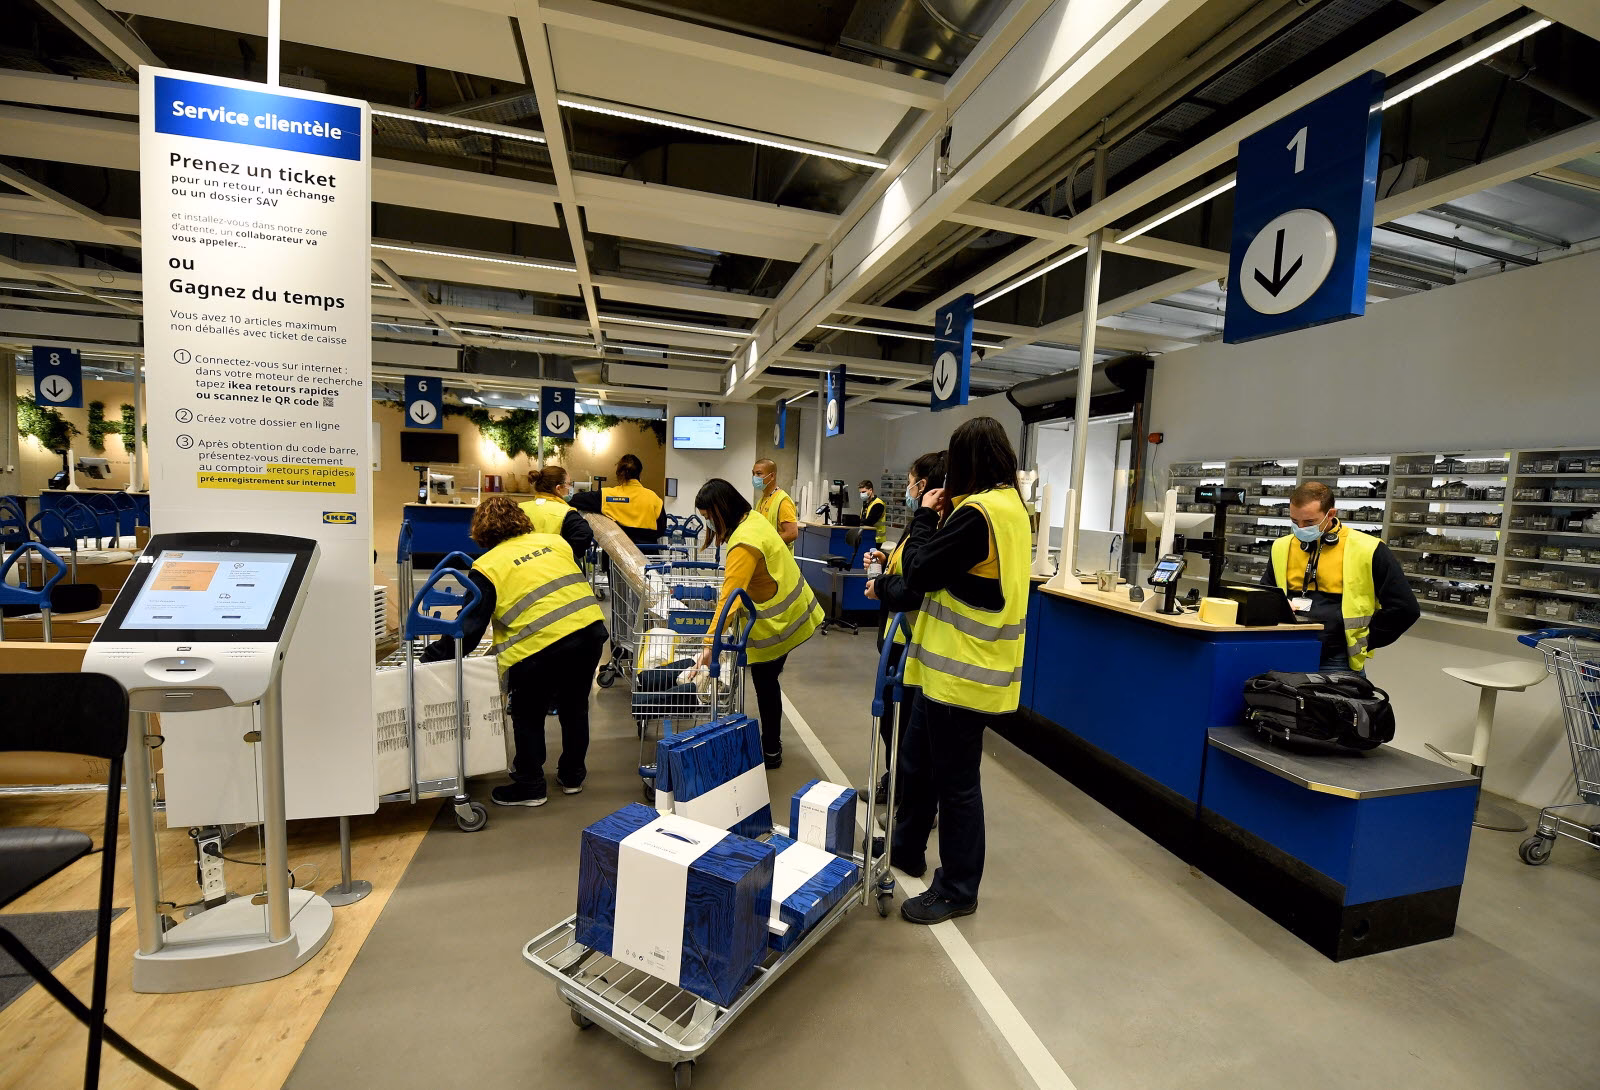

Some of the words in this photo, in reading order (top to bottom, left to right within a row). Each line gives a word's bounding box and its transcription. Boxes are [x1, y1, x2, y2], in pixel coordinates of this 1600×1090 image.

[172, 101, 249, 126] Service
[254, 113, 342, 139] clientèle
[1286, 126, 1307, 174] 1
[170, 153, 239, 174] Prenez
[247, 166, 271, 179] un
[279, 168, 336, 188] ticket
[172, 175, 200, 184] pour
[223, 182, 264, 194] retour,
[286, 188, 335, 203] échange
[210, 191, 252, 203] dossier
[256, 197, 278, 207] SAV
[184, 213, 250, 227] installez-vous
[252, 221, 275, 230] dans
[172, 235, 196, 243] vous
[236, 231, 303, 244] collaborateur
[169, 258, 194, 270] ou
[170, 279, 246, 299] Gagnez
[252, 286, 276, 301] du
[283, 291, 344, 311] temps
[170, 310, 198, 320] Vous
[201, 314, 226, 322] avez
[230, 315, 241, 323] 10
[244, 318, 282, 327] articles
[285, 322, 337, 332] maximum
[944, 312, 953, 336] 2
[195, 324, 240, 335] déballés
[270, 331, 298, 340] ticket
[301, 333, 314, 341] de
[50, 352, 60, 366] 8
[195, 355, 279, 368] Connectez-vous
[302, 363, 342, 373] internet
[195, 367, 222, 376] dans
[255, 373, 294, 381] moteur
[313, 376, 363, 386] recherche
[831, 374, 836, 389] 3
[196, 380, 225, 389] tapez
[229, 381, 252, 390] ikea
[255, 385, 296, 393] retours
[299, 387, 339, 396] rapides
[418, 380, 428, 392] 6
[214, 394, 259, 402] scannez
[262, 395, 271, 403] le
[275, 396, 291, 405] QR
[294, 398, 319, 406] code
[554, 391, 562, 403] 5
[196, 414, 226, 423] Créez
[259, 418, 297, 427] dossier
[315, 421, 340, 431] ligne
[198, 439, 229, 449] Après
[232, 441, 283, 451] obtention
[302, 445, 326, 453] code
[329, 446, 358, 455] barre,
[199, 451, 279, 462] présentez-vous
[282, 455, 343, 465] directement
[215, 465, 263, 474] comptoir
[201, 476, 284, 484] pré-enregistrement
[513, 545, 553, 567] IKEA
